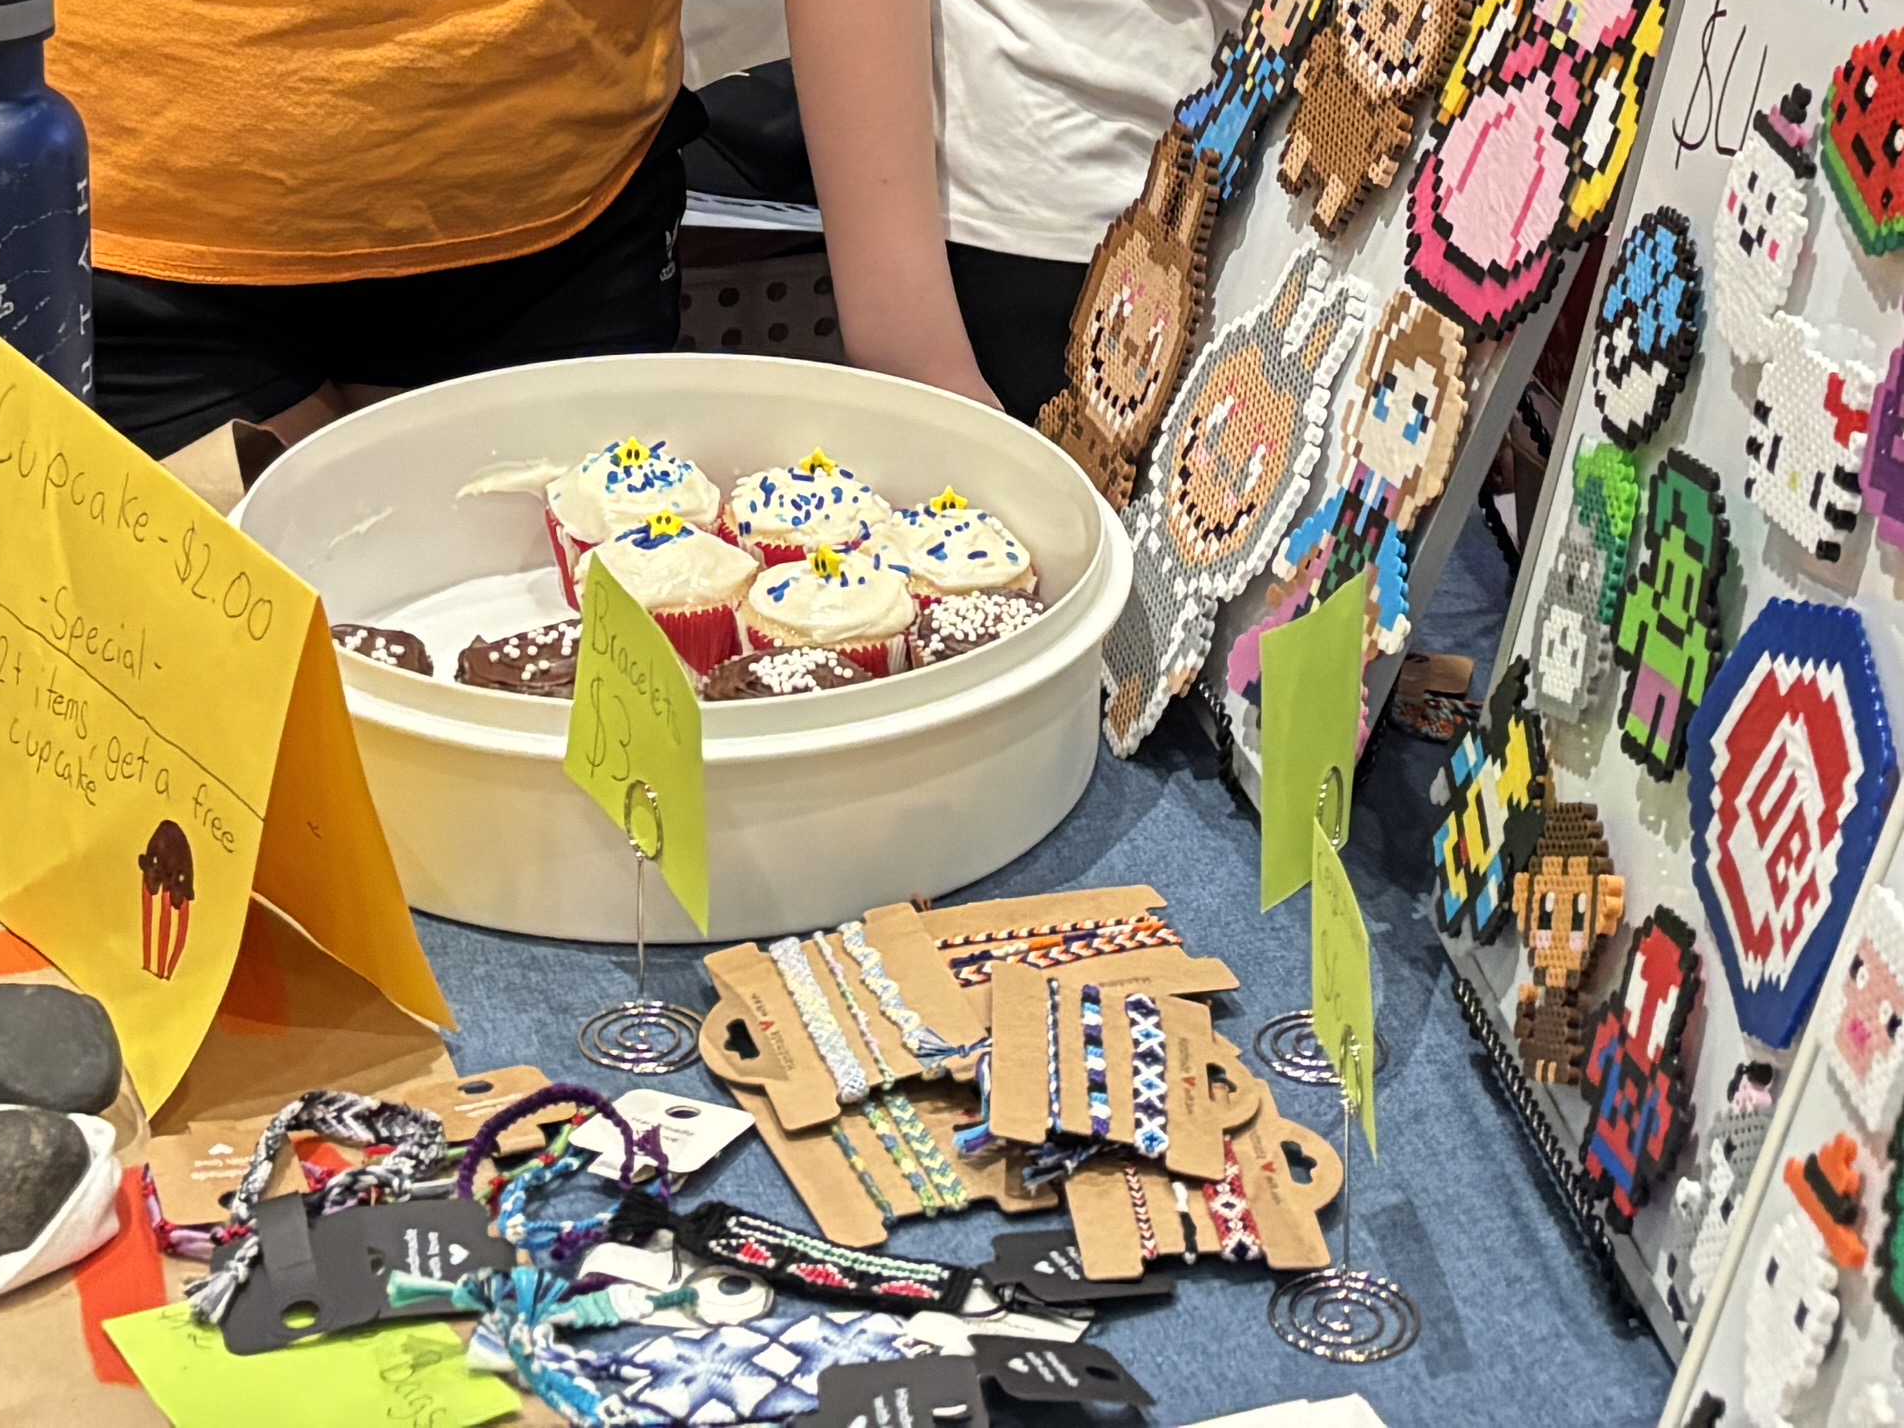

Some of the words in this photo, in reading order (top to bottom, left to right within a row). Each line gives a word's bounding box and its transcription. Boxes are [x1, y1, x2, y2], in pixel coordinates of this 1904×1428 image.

[174, 519, 273, 641] $2.00
[9, 717, 97, 807] cupcake
[585, 675, 632, 783] $3
[104, 735, 149, 783] get
[154, 767, 171, 798] a
[191, 783, 235, 853] free
